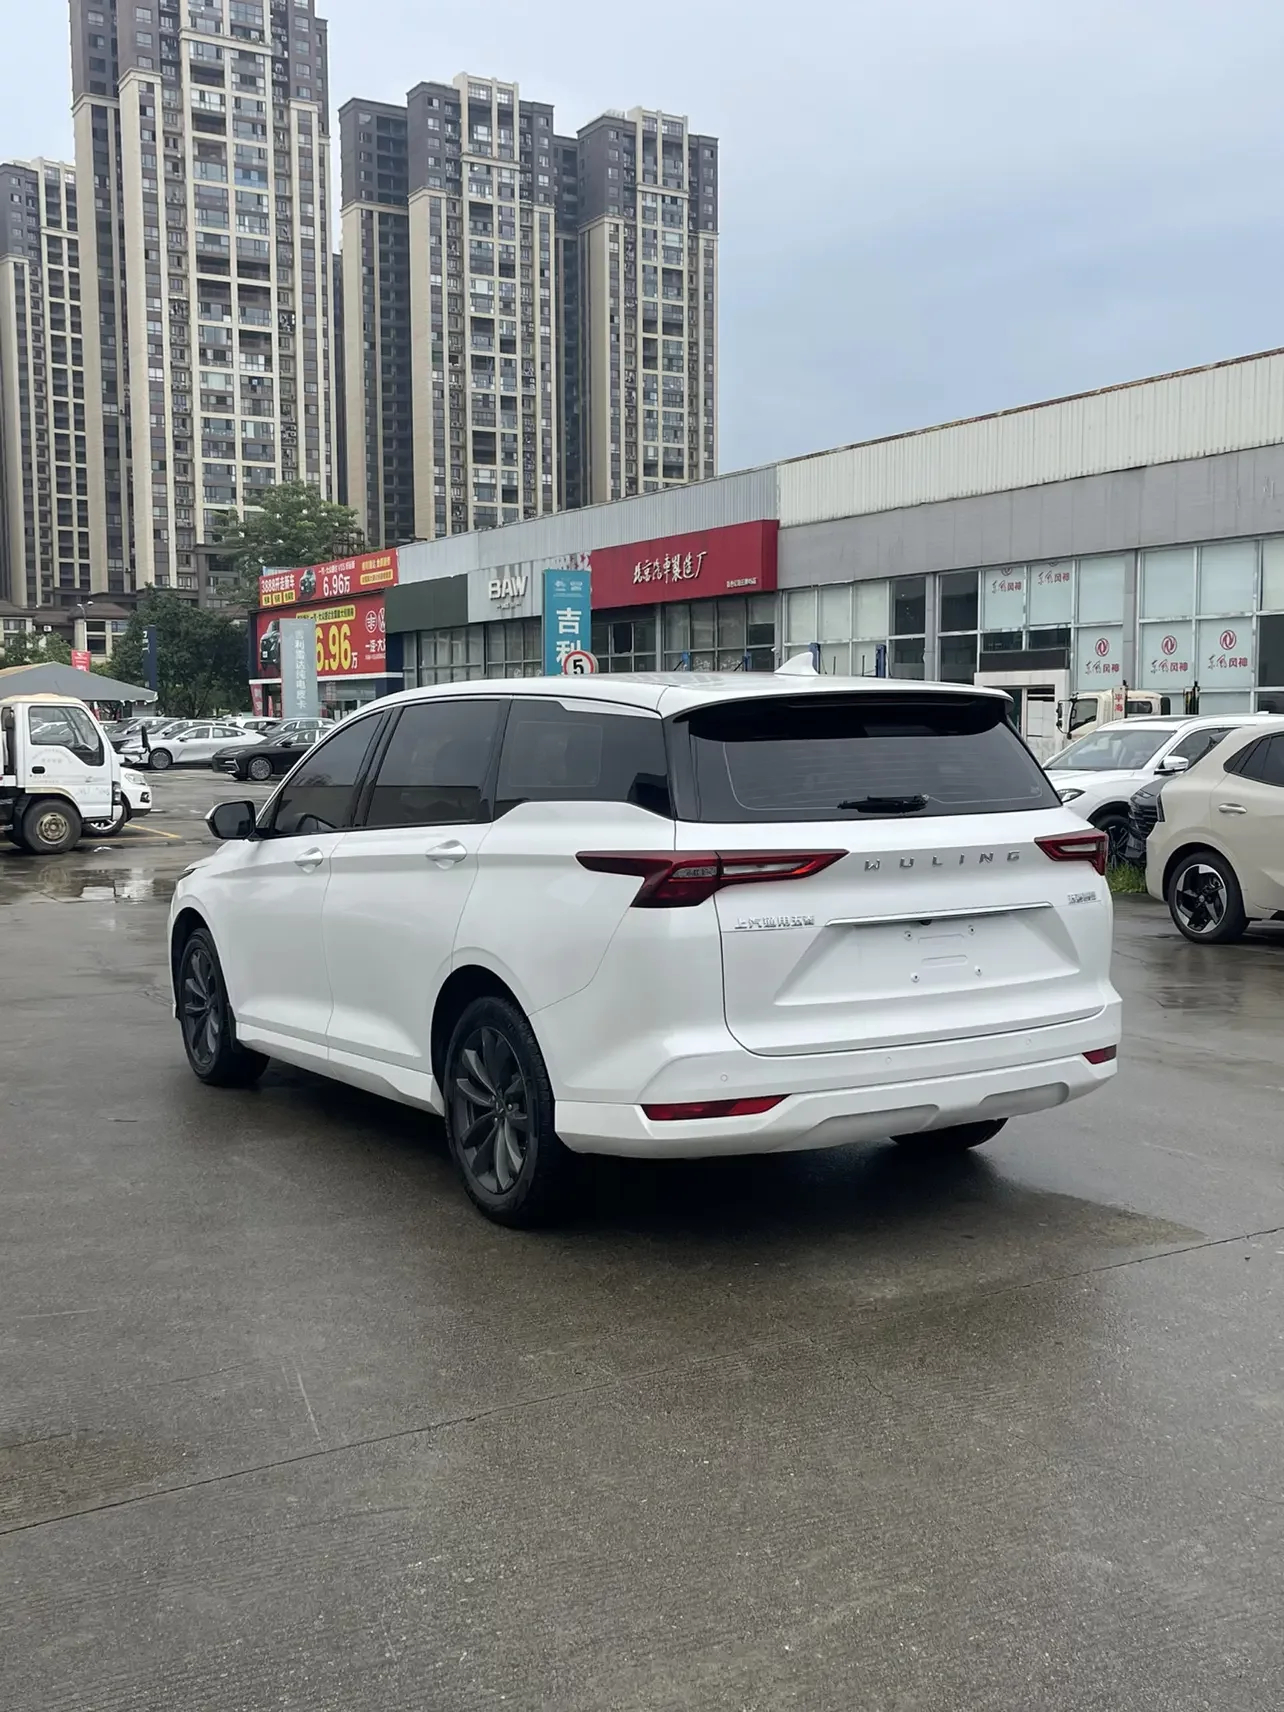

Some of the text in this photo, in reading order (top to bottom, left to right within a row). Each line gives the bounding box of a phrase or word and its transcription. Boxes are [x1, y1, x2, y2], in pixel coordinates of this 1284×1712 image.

[322, 573, 351, 597] 6.96万
[488, 575, 529, 601] BAW
[573, 658, 584, 674] 5
[864, 849, 1021, 873] WULING
